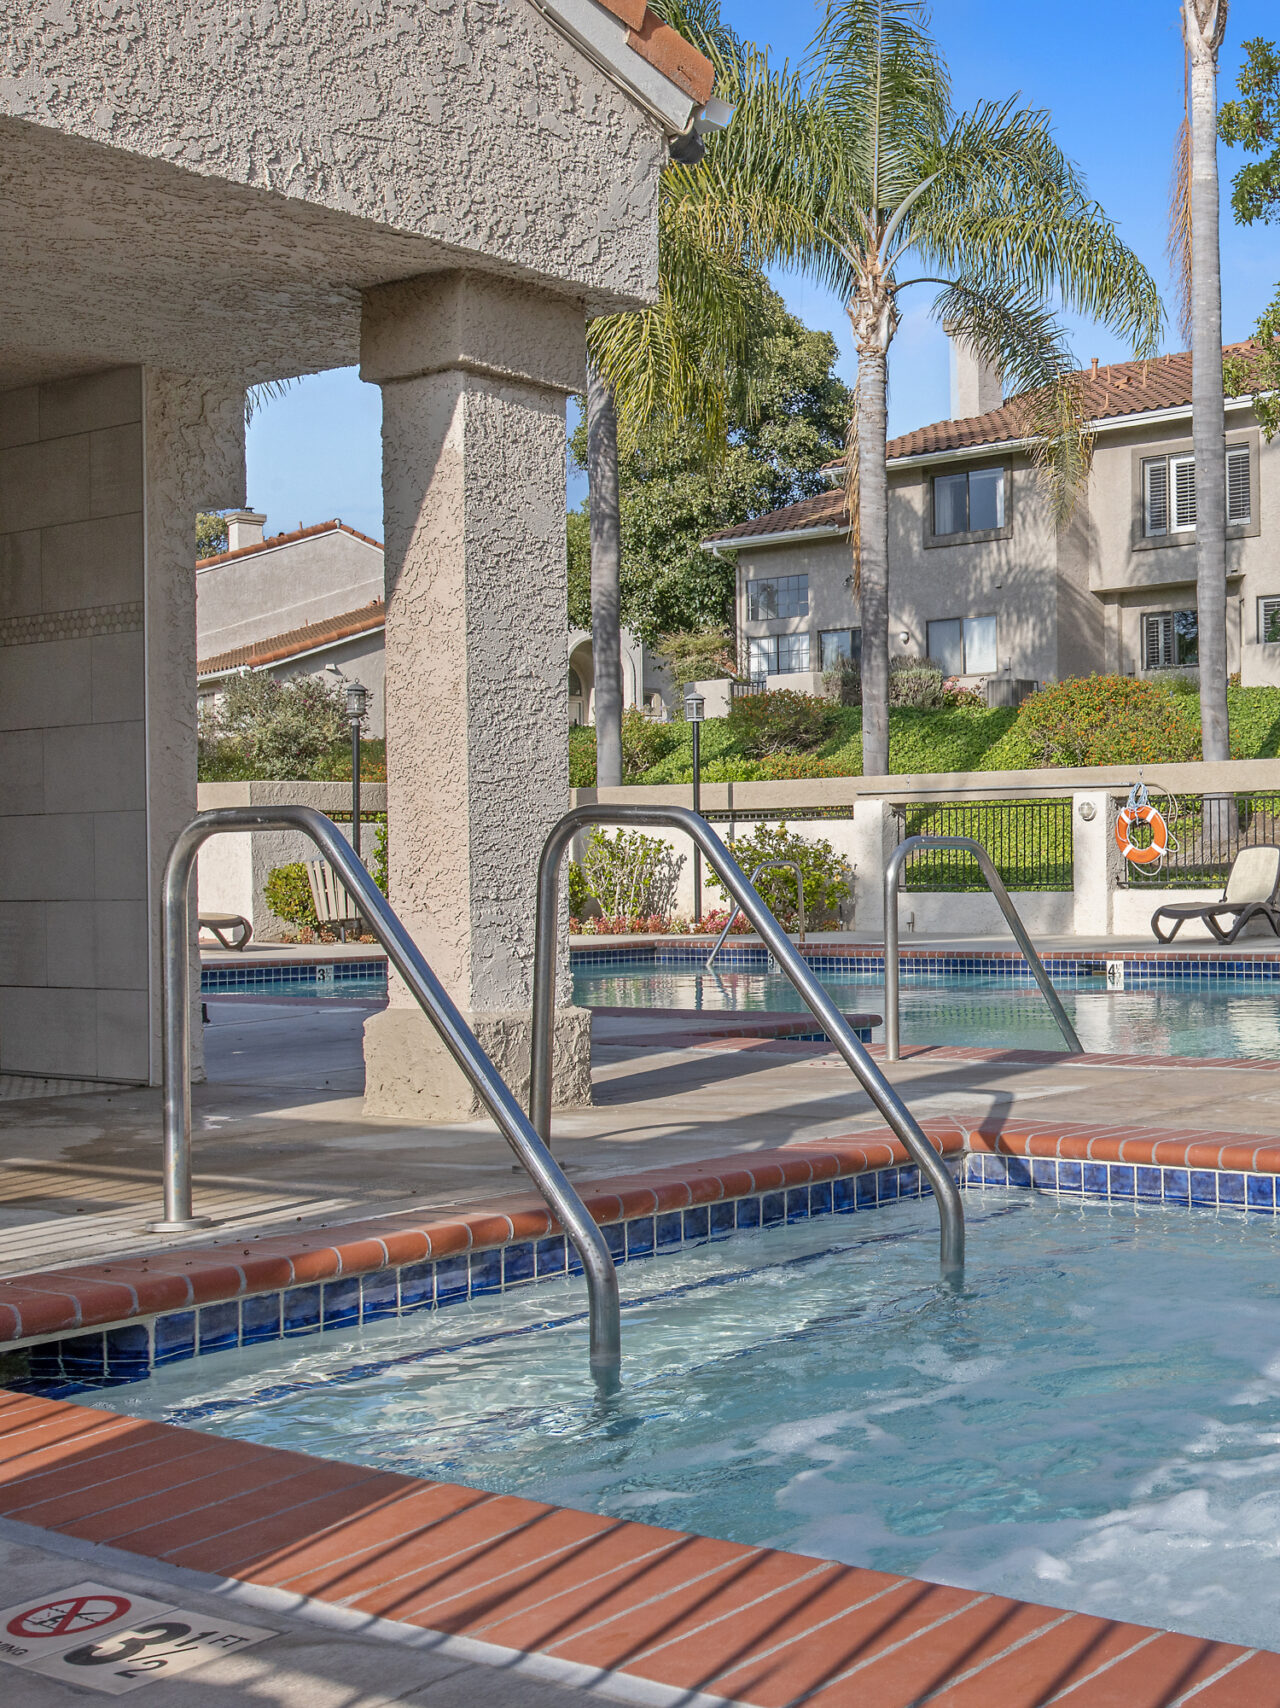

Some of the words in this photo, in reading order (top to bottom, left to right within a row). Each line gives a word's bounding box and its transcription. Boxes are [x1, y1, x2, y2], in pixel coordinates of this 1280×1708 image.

[318, 968, 325, 981] 3
[1108, 964, 1115, 976] 4
[63, 1622, 192, 1666] 3
[208, 1634, 250, 1649] FT
